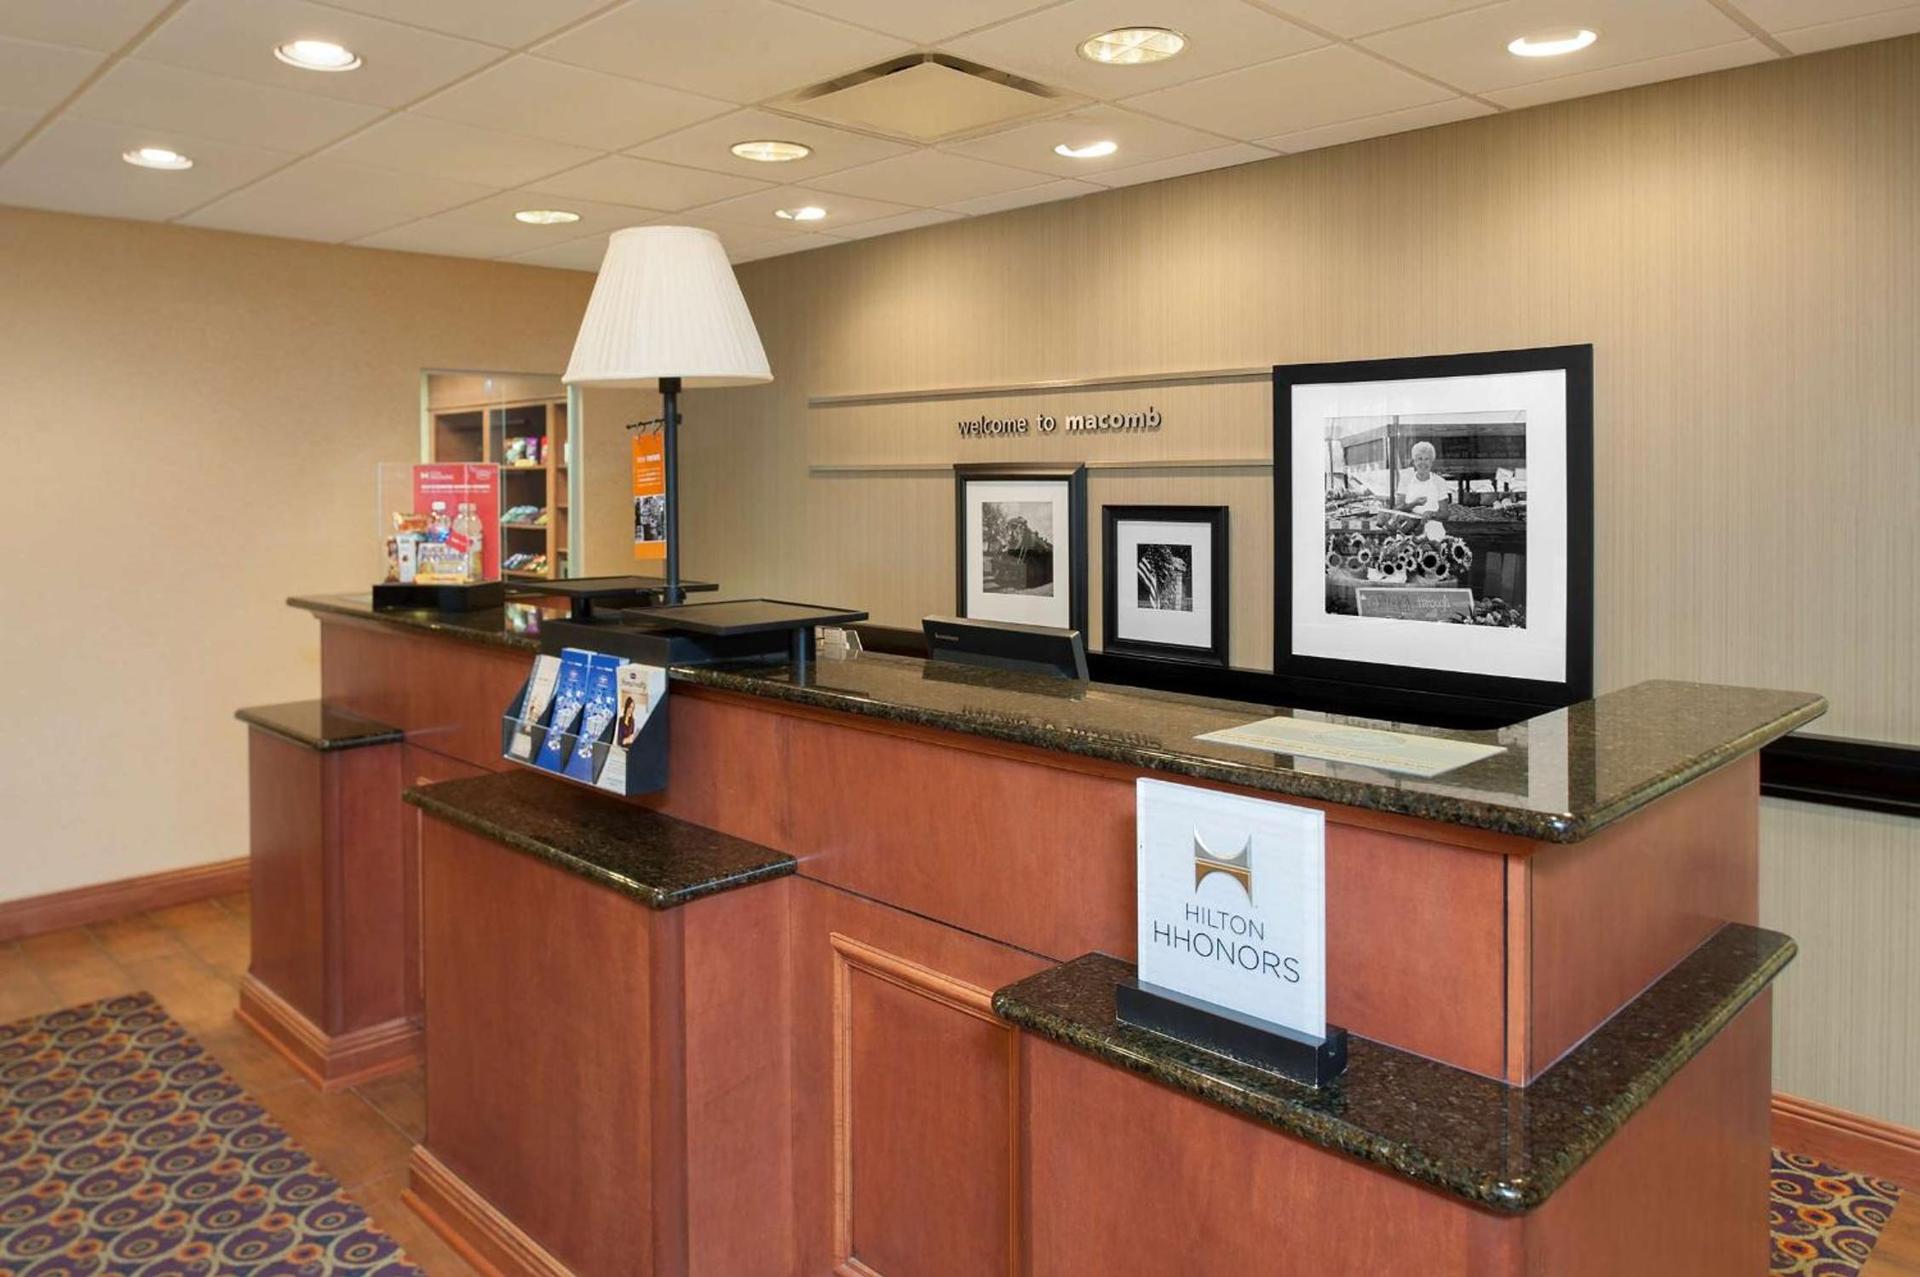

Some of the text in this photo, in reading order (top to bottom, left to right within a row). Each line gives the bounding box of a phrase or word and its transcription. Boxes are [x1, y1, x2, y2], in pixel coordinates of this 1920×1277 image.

[958, 406, 1162, 437] welcome to macomb
[1185, 903, 1264, 941] HILTON
[1153, 921, 1300, 984] HHONORS
